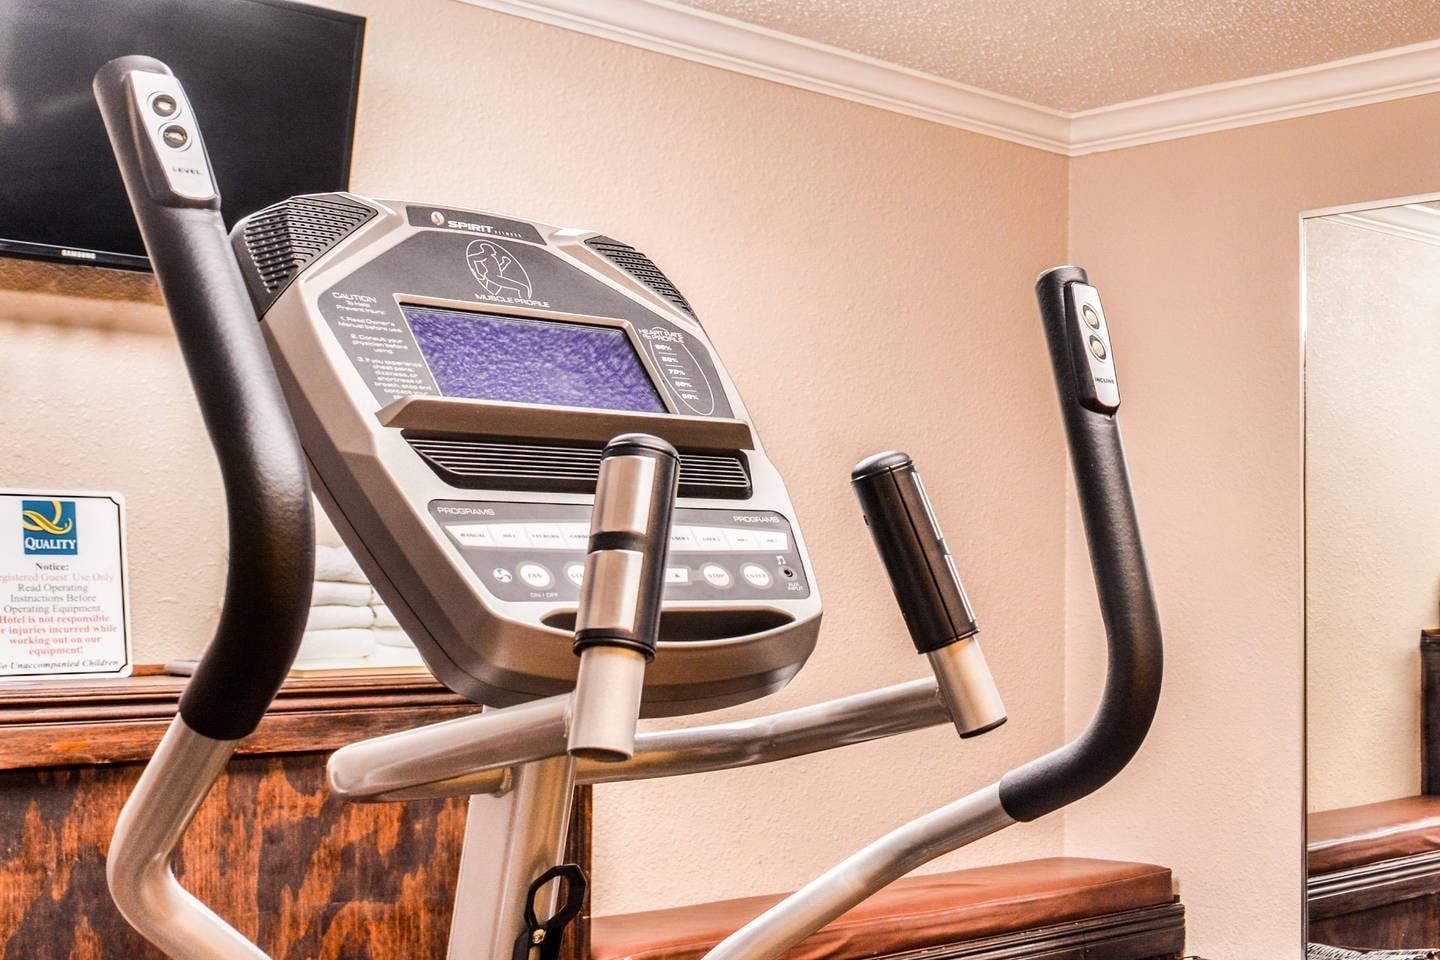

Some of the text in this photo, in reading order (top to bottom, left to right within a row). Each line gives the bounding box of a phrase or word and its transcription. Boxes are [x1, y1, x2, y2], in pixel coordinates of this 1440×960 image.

[172, 166, 202, 175] LEVEL
[448, 221, 493, 233] SPIRIT
[332, 292, 376, 303] CAUTION
[474, 294, 550, 307] MUSCLE PROFILE
[436, 506, 495, 516] PROGRAMS
[24, 537, 77, 550] QUALITY
[36, 563, 69, 571] Notice:
[44, 584, 88, 593] Operating
[10, 594, 96, 602] Instructions Before
[4, 605, 50, 614] Operating
[57, 615, 109, 624] responsible
[9, 627, 46, 635] injuries
[9, 636, 50, 645] working
